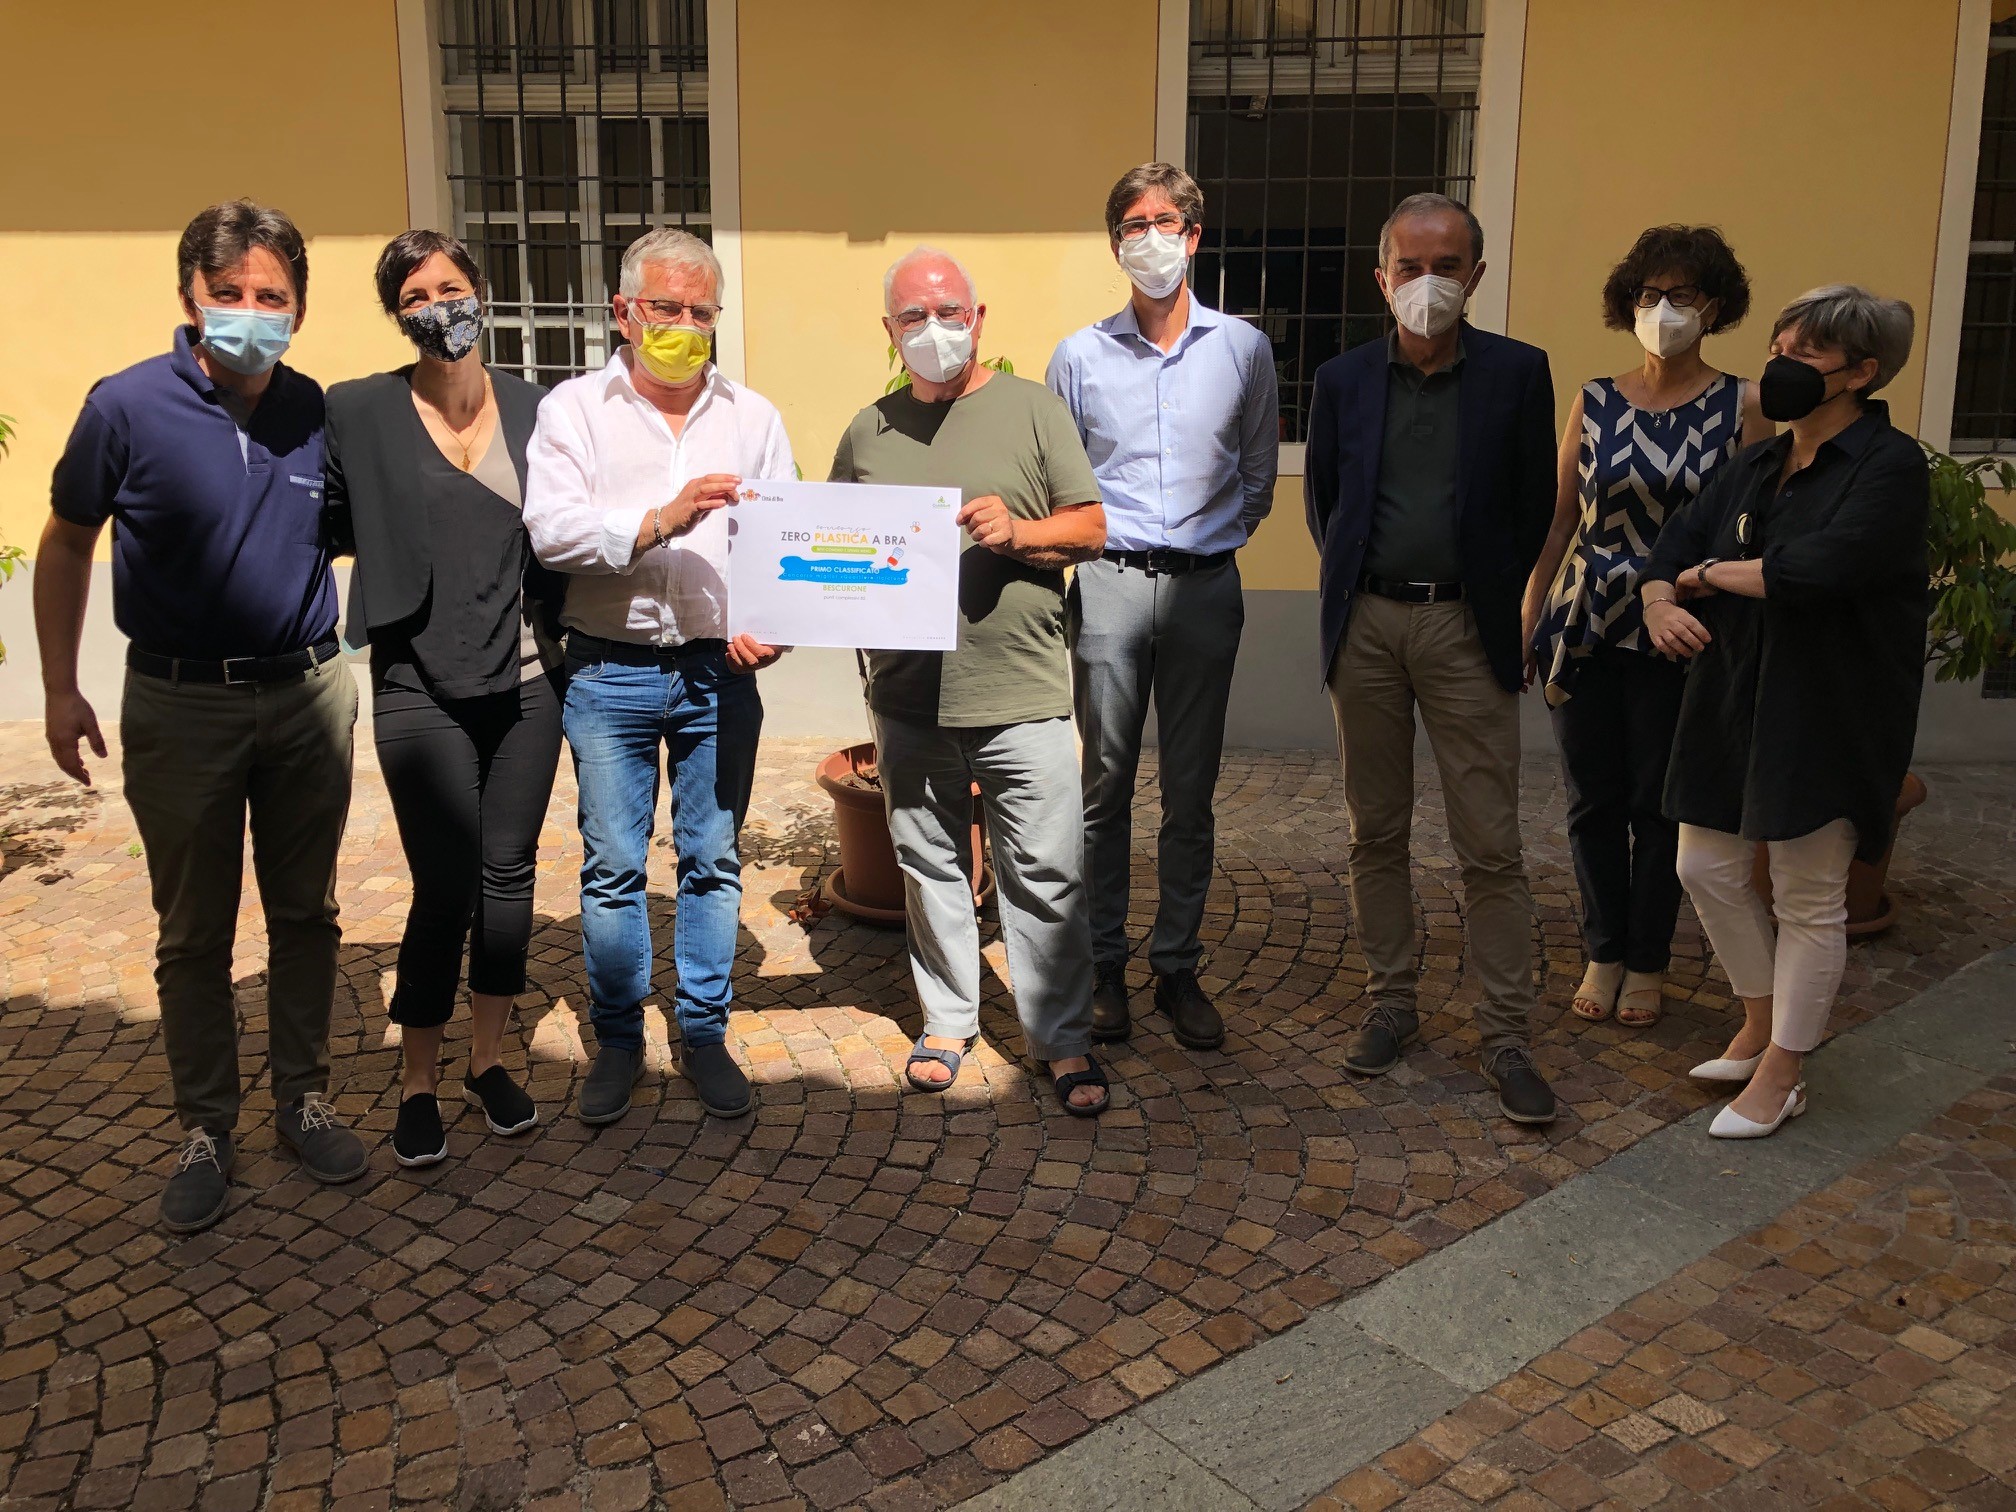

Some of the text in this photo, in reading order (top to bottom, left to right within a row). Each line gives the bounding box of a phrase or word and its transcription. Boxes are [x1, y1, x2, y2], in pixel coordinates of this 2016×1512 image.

[781, 531, 907, 546] ZERO PLASTICA A BRA
[810, 565, 880, 575] PRIMO CLASSIFICATO
[822, 584, 867, 593] BESCURONE
